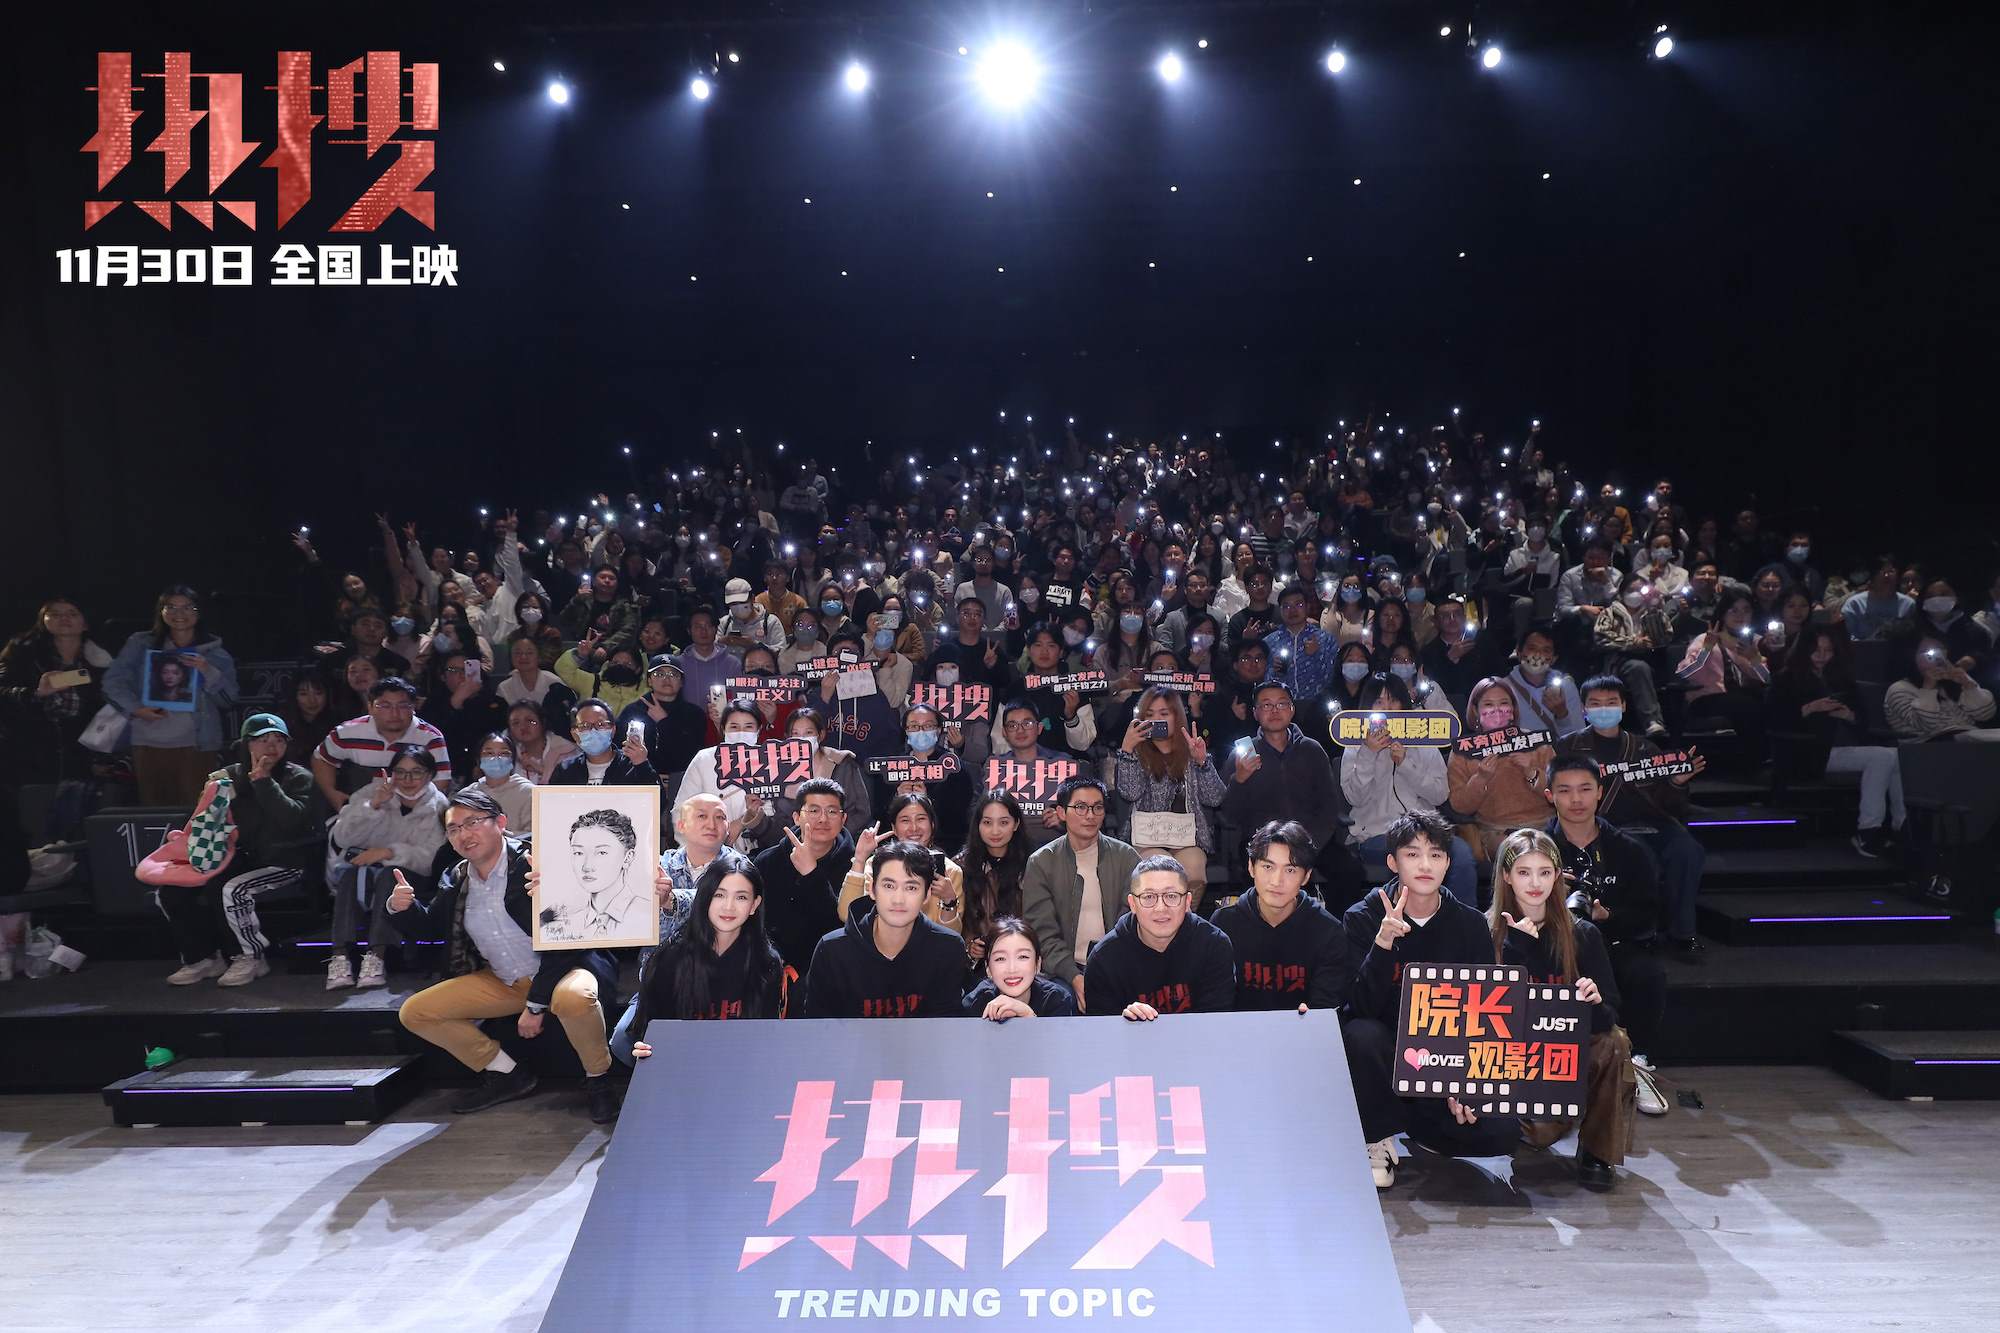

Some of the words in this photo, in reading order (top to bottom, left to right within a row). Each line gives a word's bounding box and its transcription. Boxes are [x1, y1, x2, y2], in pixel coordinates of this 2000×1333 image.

[1025, 672, 1098, 688] 你的每一次发声
[1054, 680, 1107, 692] 都有千钧之力
[911, 683, 990, 720] 热搜
[1340, 717, 1450, 739] 院观影团
[1457, 730, 1508, 751] 不旁观
[718, 741, 811, 787] 热搜
[888, 765, 944, 781] 回归真相
[1623, 763, 1692, 782] 都有千钧之力
[985, 760, 1077, 800] 热搜
[1408, 983, 1513, 1039] 院长
[1532, 1017, 1578, 1032] JUST
[1417, 1054, 1464, 1067] MOVIE
[1466, 1041, 1579, 1082] 观影团
[737, 1076, 1215, 1272] 热搜
[774, 1288, 1001, 1319] TRENDING
[1020, 1287, 1156, 1318] TOPIC
